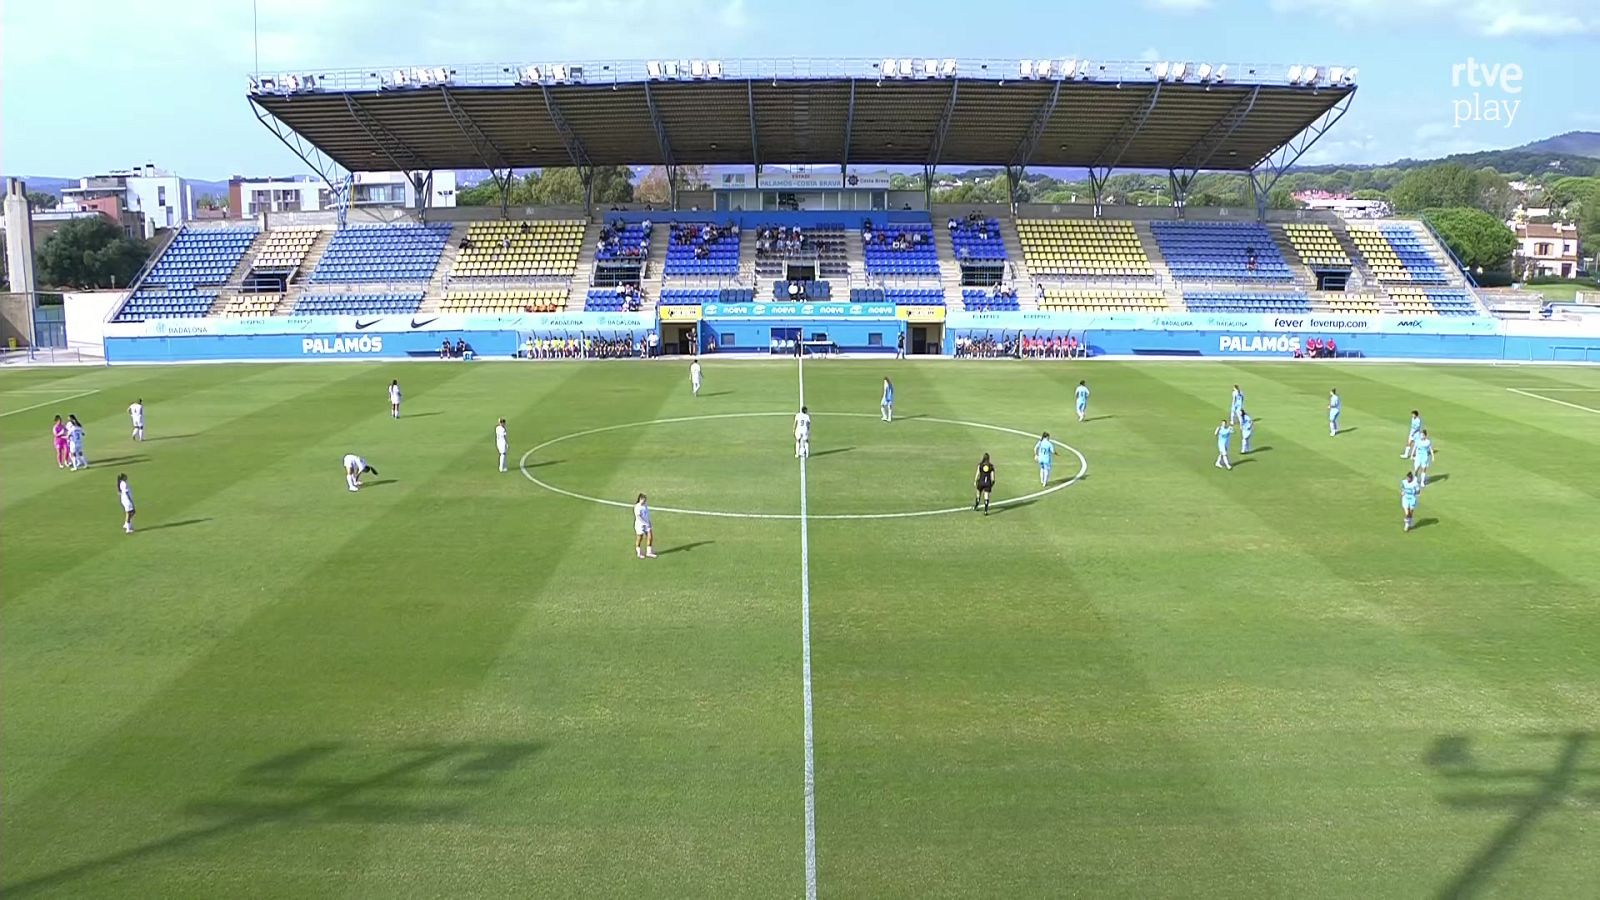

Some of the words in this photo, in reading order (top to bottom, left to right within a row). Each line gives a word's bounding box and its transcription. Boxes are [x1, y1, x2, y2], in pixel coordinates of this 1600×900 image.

[1274, 318, 1303, 328] fever
[1310, 318, 1367, 329] feverup.com
[302, 333, 383, 354] PALAMÓS
[1219, 333, 1300, 352] PALAMÓS
